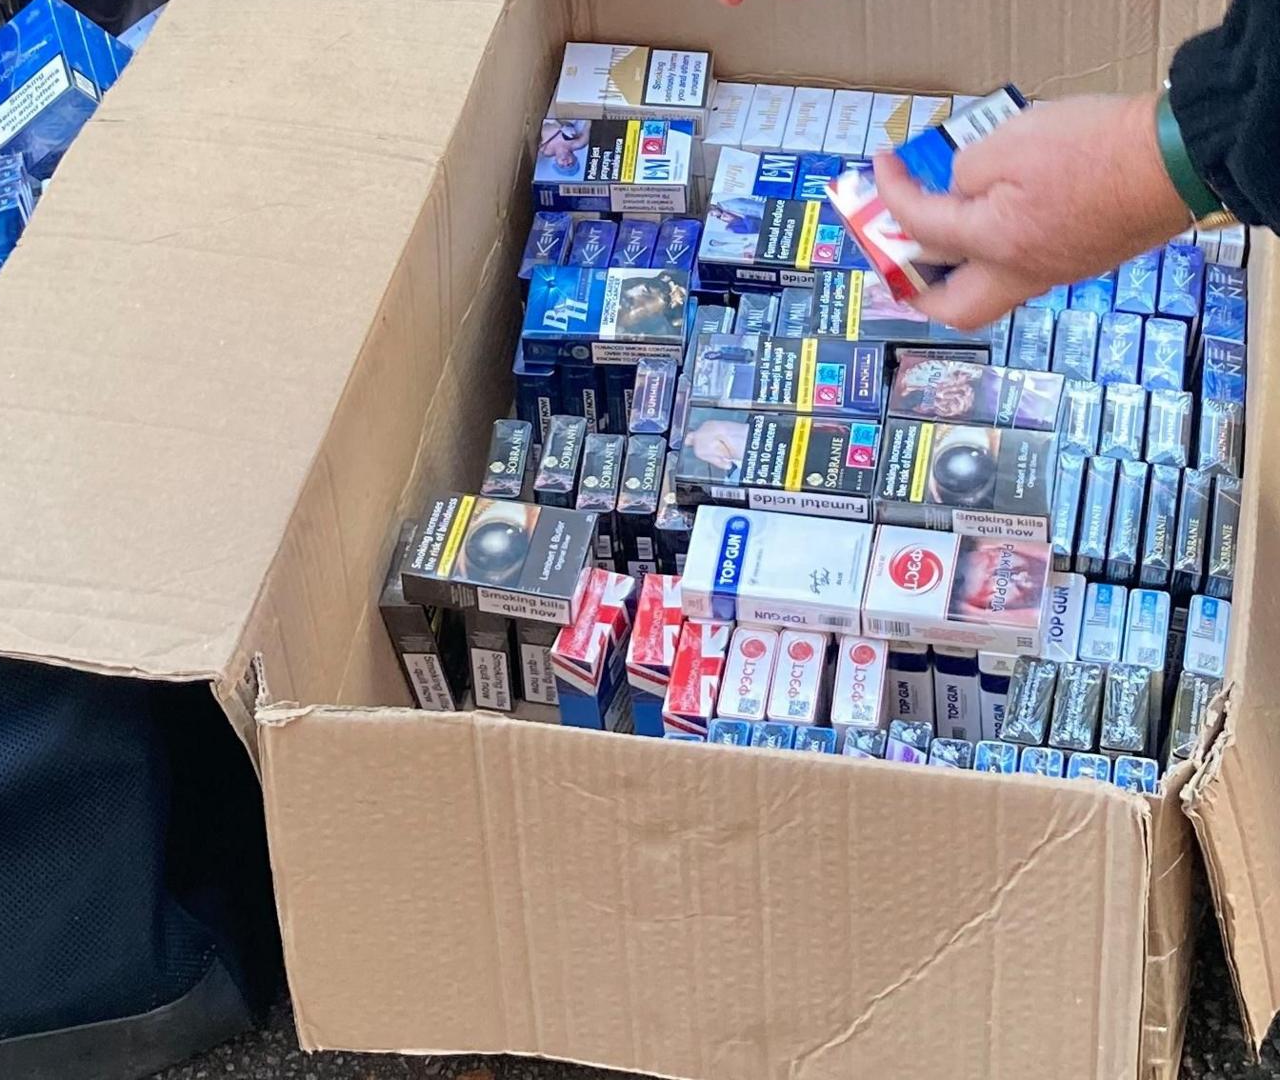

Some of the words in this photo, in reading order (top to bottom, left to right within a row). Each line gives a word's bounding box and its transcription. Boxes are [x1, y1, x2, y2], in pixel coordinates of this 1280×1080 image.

[652, 61, 666, 90] Smoking
[680, 55, 690, 74] others
[694, 60, 702, 73] you
[9, 74, 45, 106] Smoking
[34, 68, 60, 92] harms
[665, 72, 676, 102] seriously
[679, 74, 687, 88] and
[690, 72, 699, 96] around
[0, 116, 17, 133] you
[18, 101, 34, 118] and
[34, 78, 60, 102] others
[678, 88, 686, 102] you
[10, 104, 38, 133] around
[39, 91, 56, 108] you
[643, 159, 671, 180] L&M
[759, 155, 798, 183] L&M
[800, 173, 832, 199] L&M
[536, 221, 560, 257] KENT
[764, 227, 780, 258] Fumatul
[773, 199, 786, 227] reduce
[778, 219, 796, 260] fertilitatea
[582, 227, 606, 265] KENT
[623, 228, 648, 265] KENT
[666, 226, 690, 264] KENT
[782, 272, 815, 284] ucide
[818, 304, 829, 334] Fumatul
[787, 352, 797, 370] dragi
[859, 353, 871, 397] DUNHILL
[648, 377, 660, 416] DUNHILL
[784, 379, 792, 405] pentru
[559, 423, 579, 469] SOBRANIE
[743, 450, 756, 484] Fumatul
[751, 415, 765, 450] cauzează
[763, 423, 777, 451] cancere
[891, 429, 904, 464] increases
[905, 426, 917, 461] blindness
[506, 429, 524, 474] SOBRANIE
[761, 451, 771, 461] 10
[772, 443, 787, 486] pulmonare
[824, 437, 844, 488] SOBRANIE
[600, 442, 617, 489] SOBRANIE
[642, 444, 659, 490] SOBRANIE
[759, 461, 770, 478] din
[900, 470, 909, 485] risk
[903, 460, 911, 470] of
[1014, 468, 1026, 499] Lambert
[1021, 442, 1030, 461] Butler
[756, 477, 766, 485] 9
[884, 464, 899, 496] Smoking
[896, 485, 906, 497] the
[753, 493, 796, 504] ucide
[802, 499, 864, 513] Fumatul
[439, 498, 458, 531] blindness
[956, 512, 1013, 528] Smoking
[1017, 517, 1044, 528] kills
[412, 534, 433, 570] Smoking
[425, 501, 445, 534] increases
[436, 530, 445, 541] of
[552, 521, 567, 543] Butler
[978, 525, 1003, 537] quit
[1007, 528, 1034, 537] now
[431, 540, 441, 558] risk
[549, 542, 558, 550] &
[726, 534, 743, 559] GUN
[998, 543, 1015, 565] РАК
[425, 557, 436, 571] the
[540, 549, 554, 580] Lambert
[719, 560, 737, 585] TOP
[903, 548, 923, 591] ФЭСТ
[481, 590, 537, 608] Smoking
[539, 599, 566, 611] kills
[991, 571, 1011, 613] ГОРЛА
[1053, 586, 1068, 614] GUN
[502, 603, 527, 615] quit
[529, 608, 557, 618] now
[754, 610, 781, 620] GUN
[781, 614, 809, 624] TOP
[1049, 615, 1065, 643] TOP
[478, 664, 490, 682] quit
[492, 653, 504, 690] Smoking
[526, 659, 538, 677] quit
[738, 660, 756, 696] ФЭСТ
[788, 663, 804, 698] ФЭСТ
[415, 669, 426, 686] quit
[422, 687, 433, 703] now
[423, 656, 443, 690] Smoking
[436, 692, 449, 711] kills
[482, 682, 491, 699] now
[530, 677, 540, 694] now
[851, 666, 867, 702] ФЭСТ
[898, 681, 908, 697] GUN
[947, 685, 958, 701] GUN
[496, 691, 506, 707] kills
[899, 697, 911, 714] TOP
[948, 702, 959, 719] TOP
